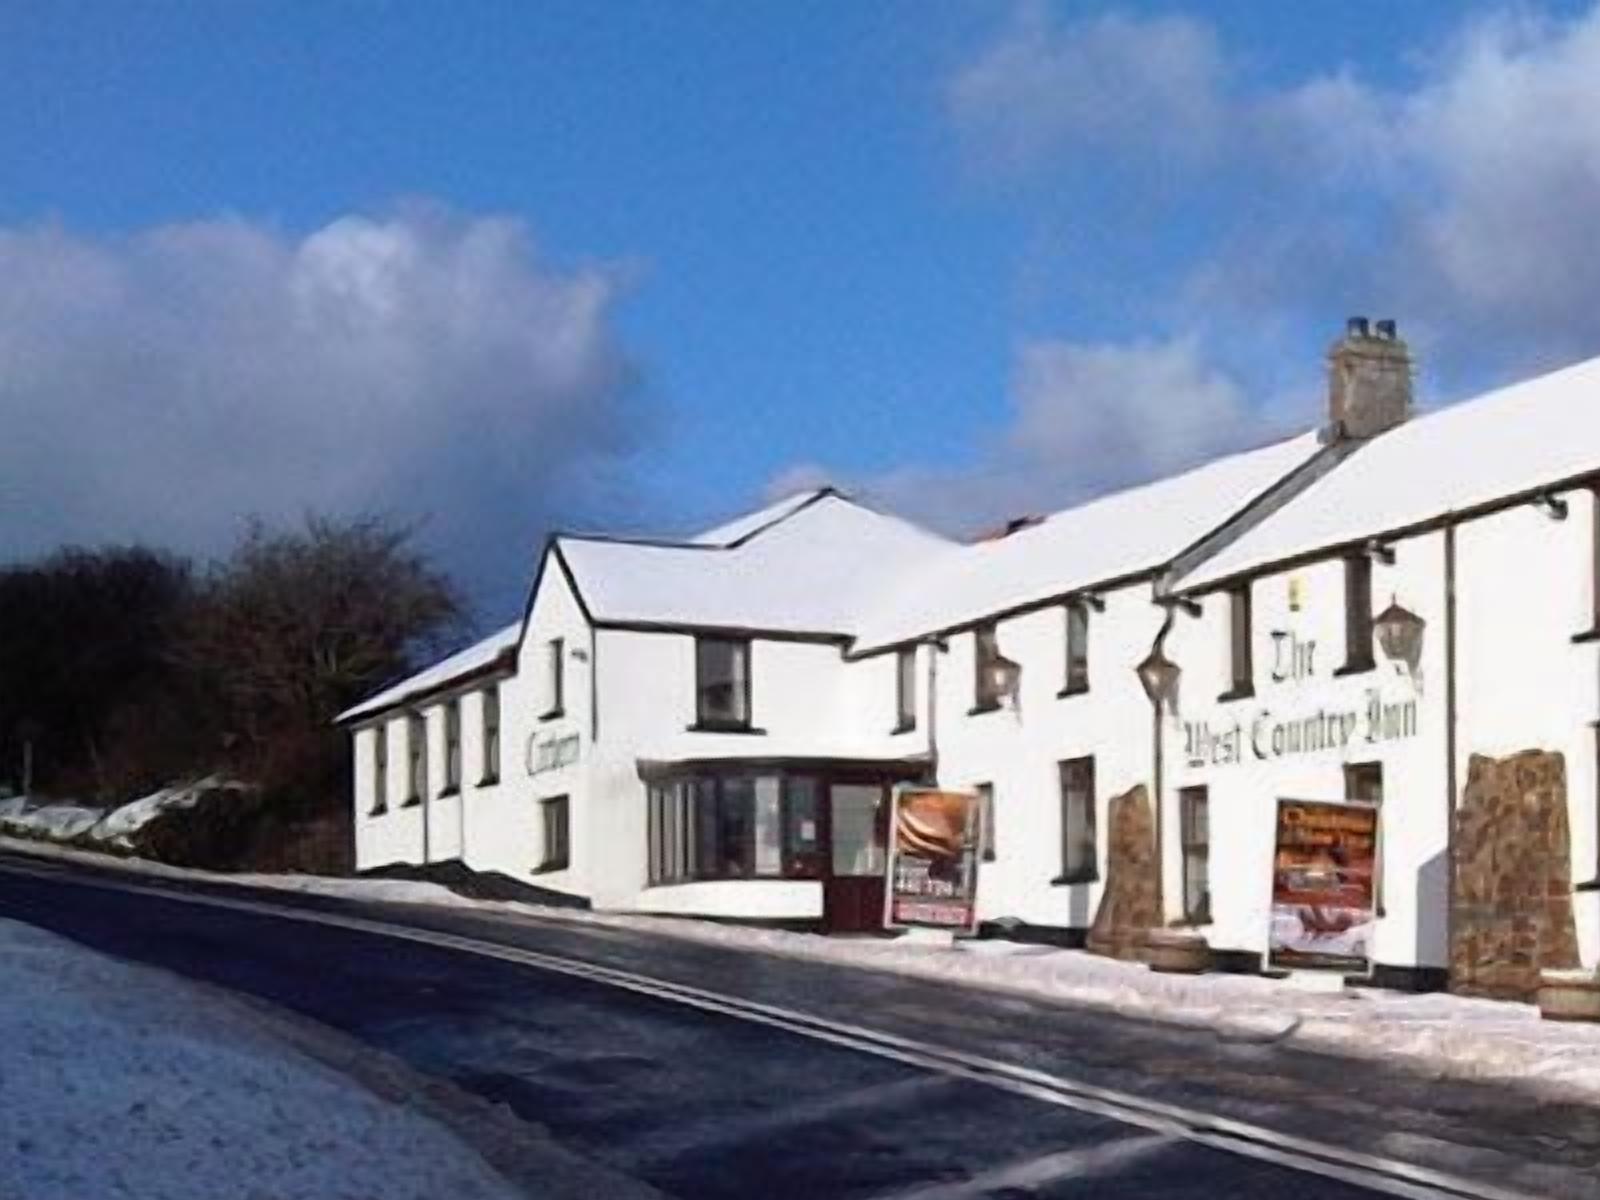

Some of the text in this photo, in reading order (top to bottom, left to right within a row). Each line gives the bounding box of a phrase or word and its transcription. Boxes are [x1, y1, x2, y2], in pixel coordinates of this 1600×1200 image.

[1269, 630, 1317, 685] The
[1184, 688, 1417, 768] West Country Inn
